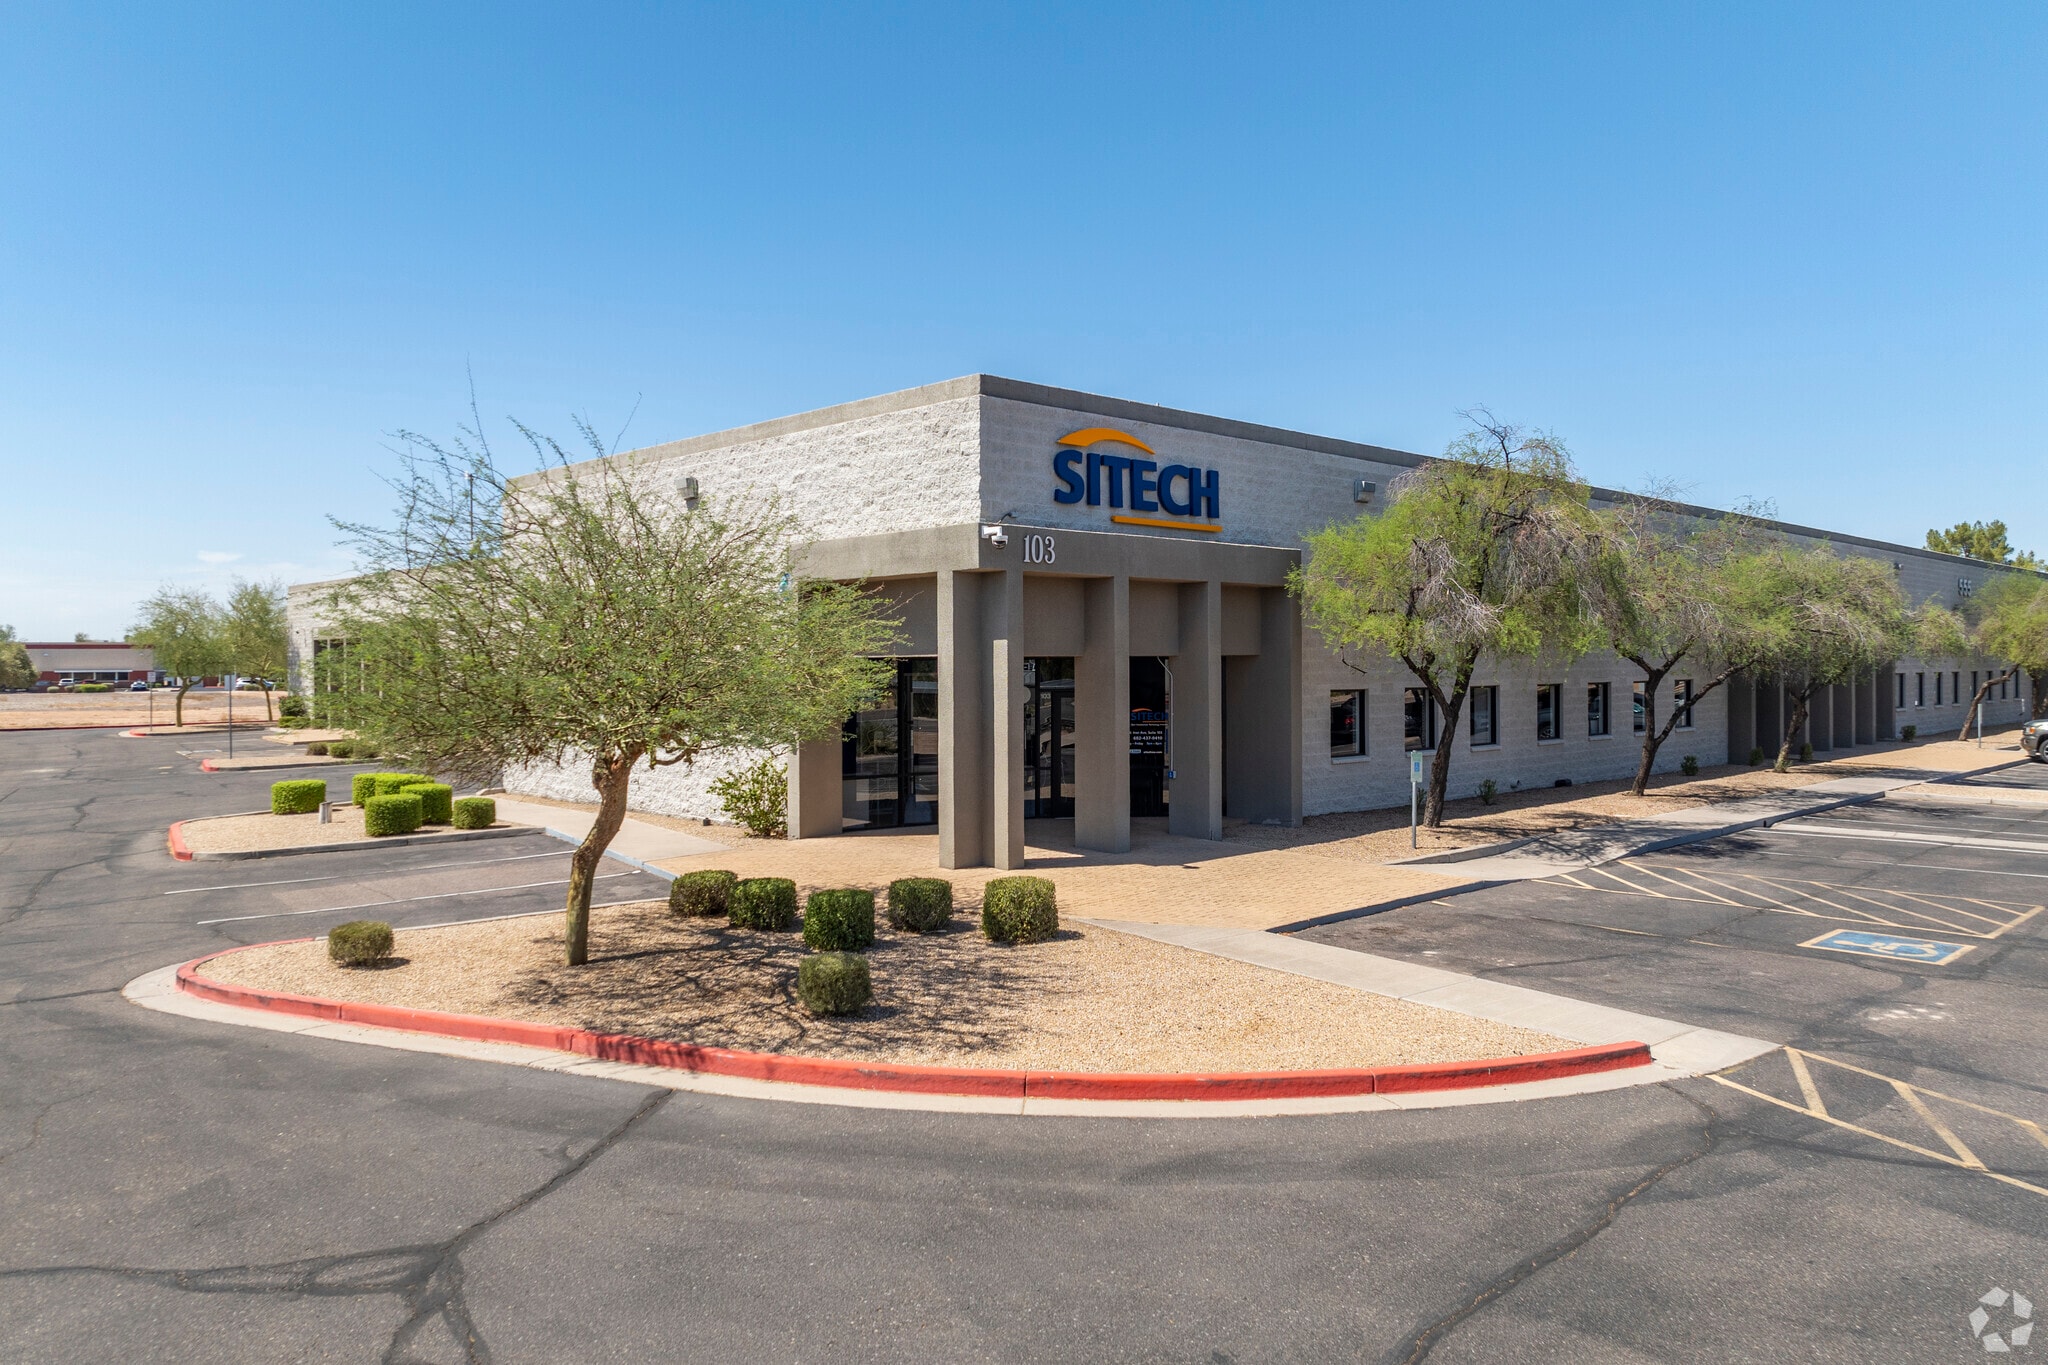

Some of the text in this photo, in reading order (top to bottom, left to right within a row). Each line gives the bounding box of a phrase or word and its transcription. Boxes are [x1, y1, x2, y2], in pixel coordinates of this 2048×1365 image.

[1053, 449, 1219, 518] SITECH
[1023, 534, 1056, 564] 103
[1131, 711, 1168, 720] SITECH
